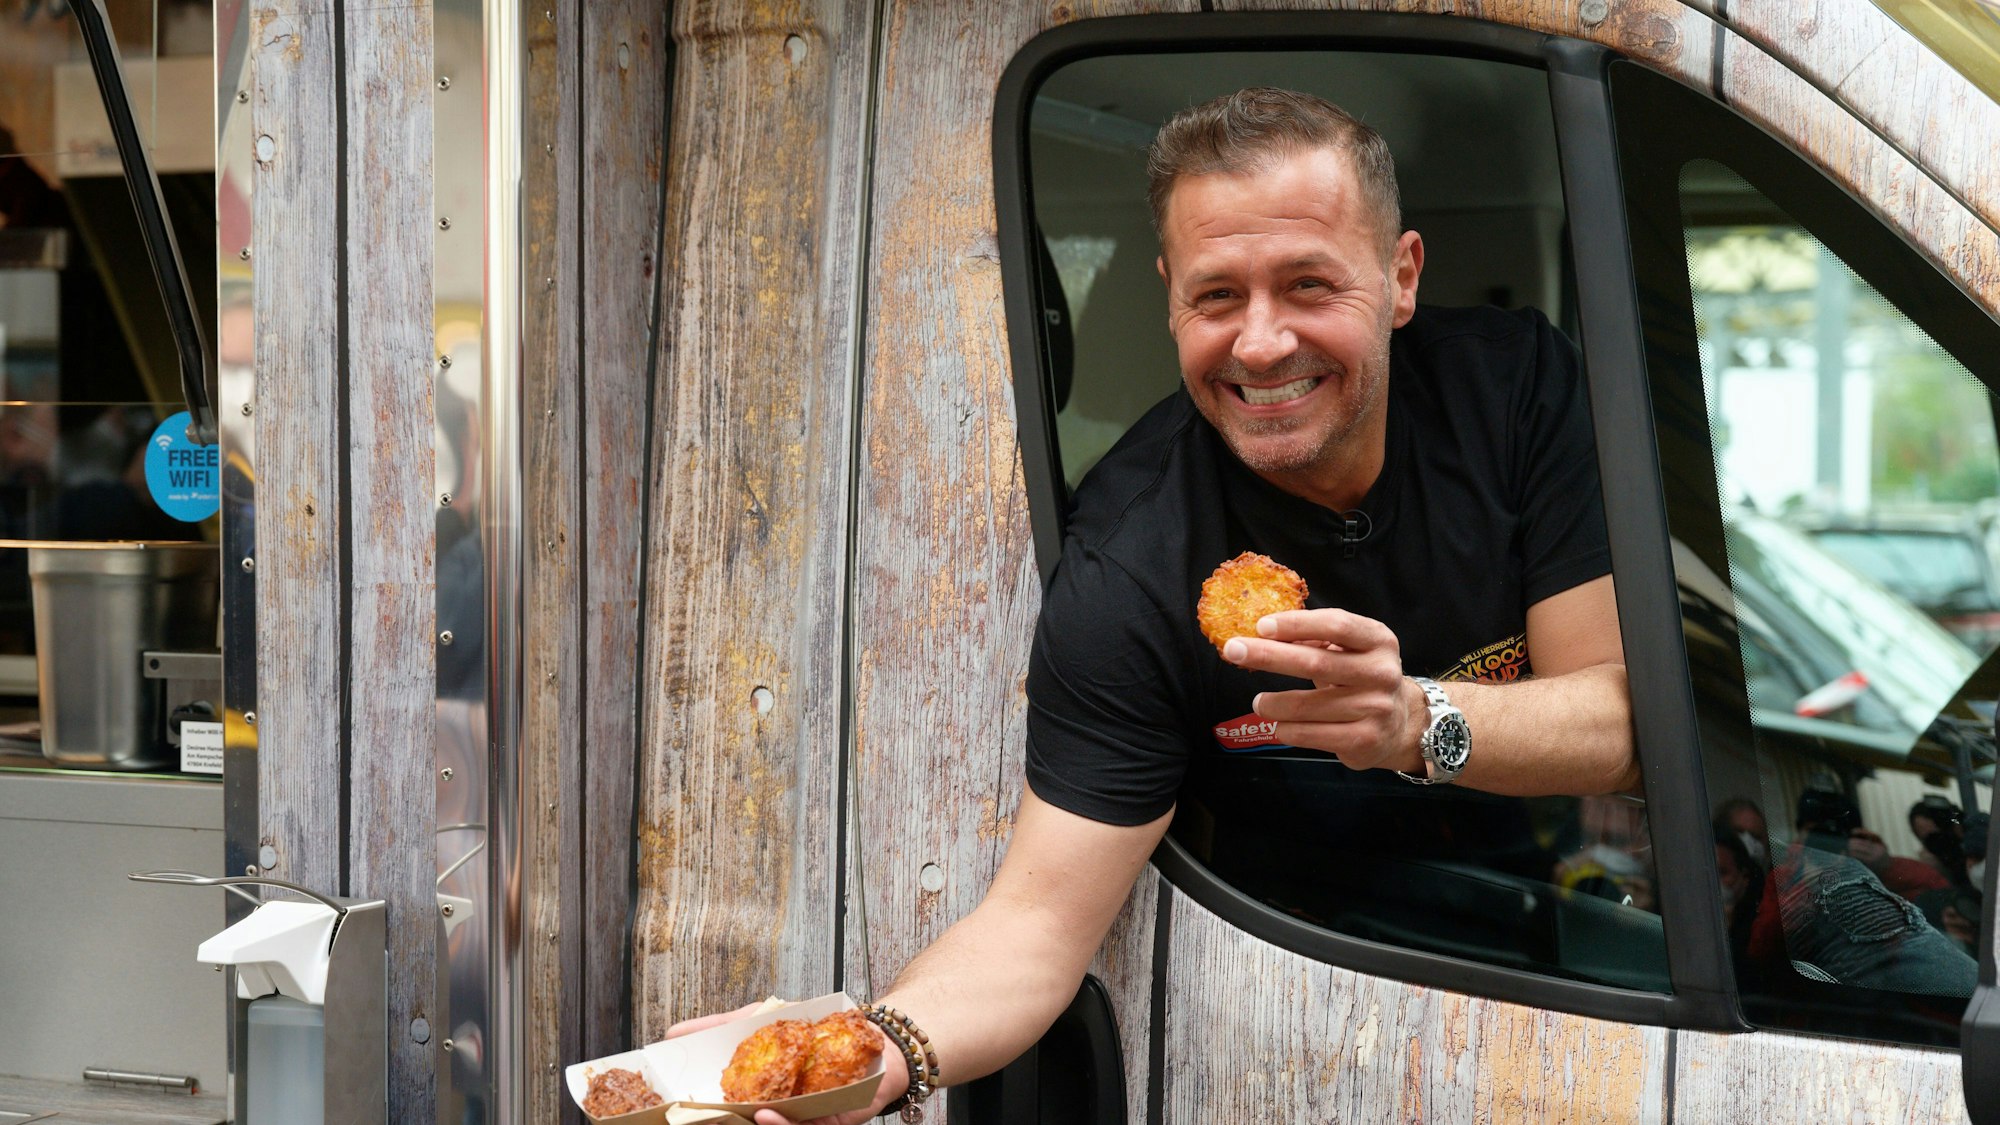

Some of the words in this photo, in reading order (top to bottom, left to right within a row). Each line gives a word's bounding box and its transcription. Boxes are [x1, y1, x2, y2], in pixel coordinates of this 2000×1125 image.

[169, 449, 218, 467] FREE
[169, 470, 210, 487] WIFI
[1460, 649, 1481, 664] WILLI
[1482, 637, 1514, 656] HERREN'S
[1215, 721, 1278, 737] Safety
[1234, 735, 1273, 743] Fahrschule
